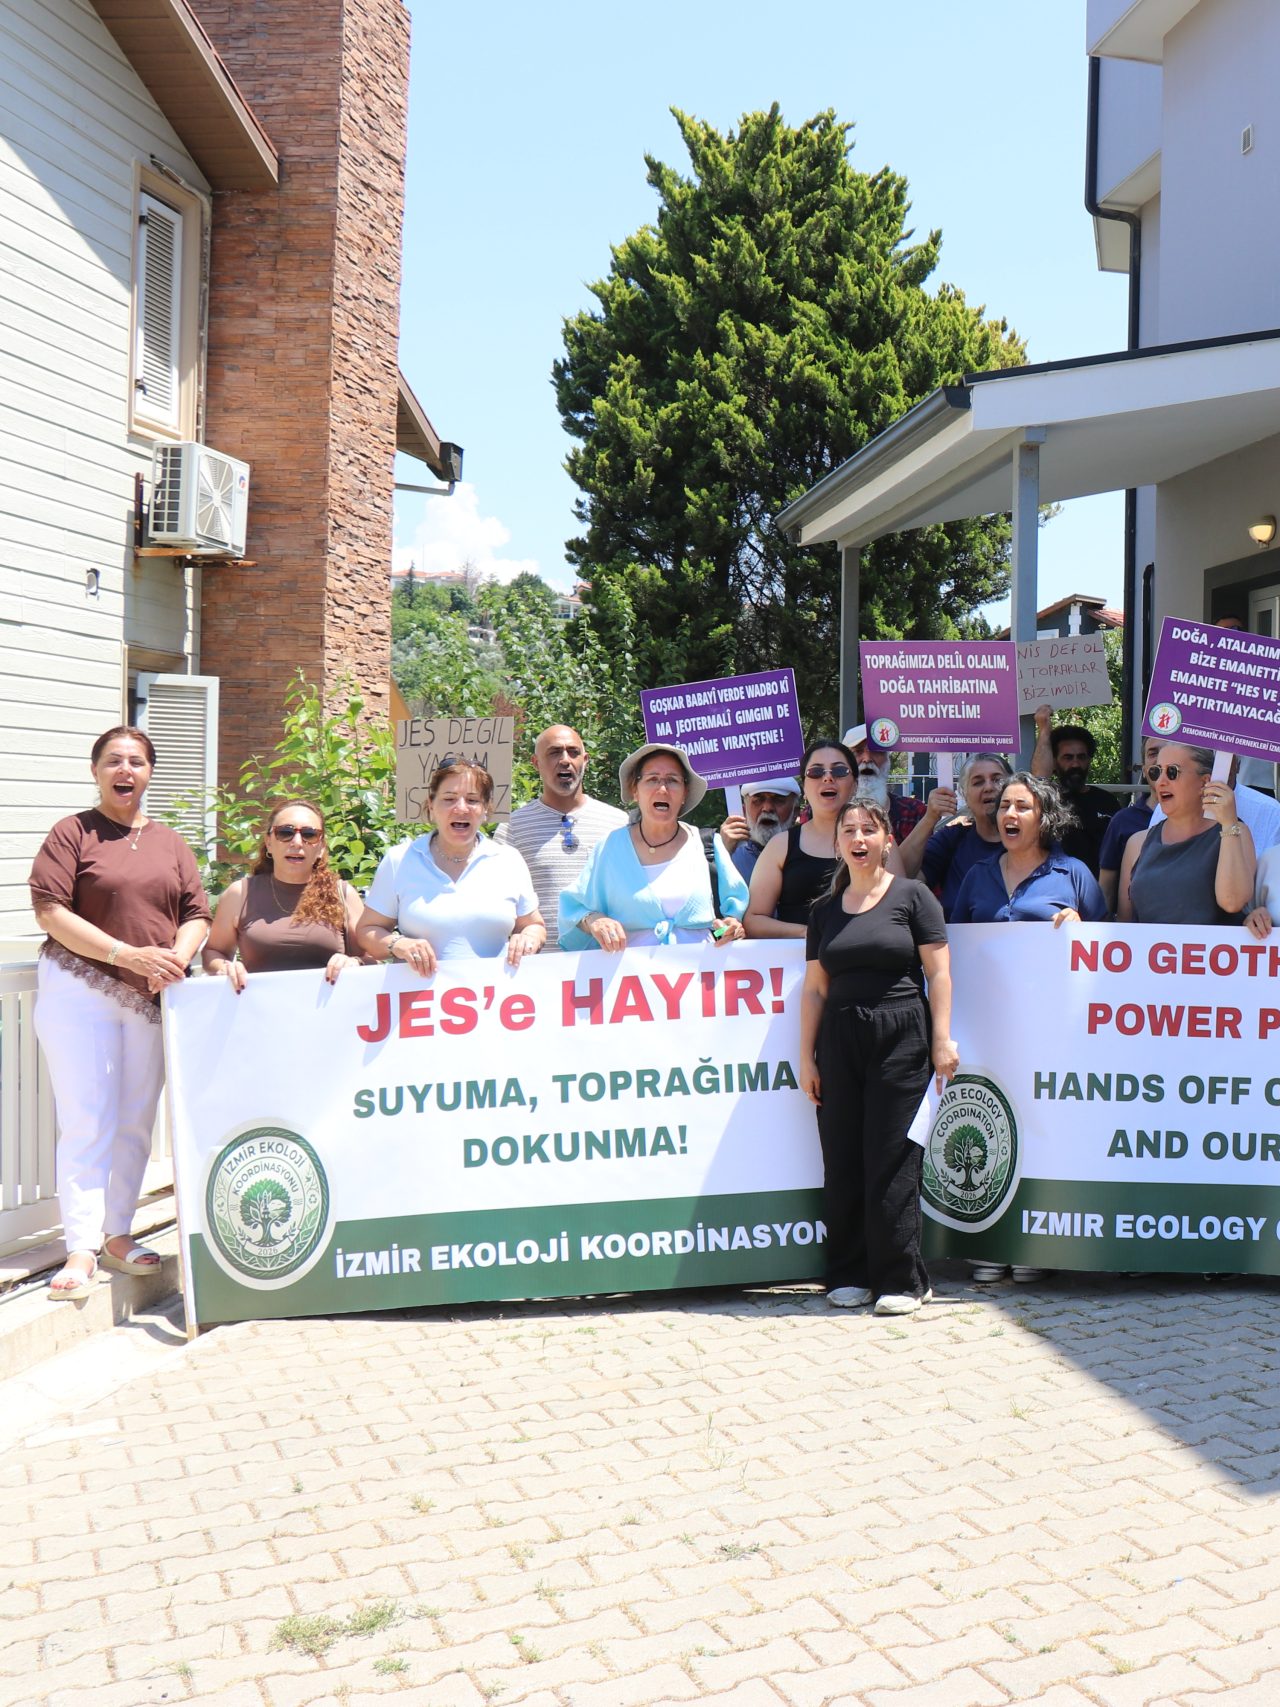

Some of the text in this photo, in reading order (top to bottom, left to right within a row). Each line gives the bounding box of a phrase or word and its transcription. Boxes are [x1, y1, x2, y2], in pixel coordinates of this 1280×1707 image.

[1171, 627, 1209, 646] DOĞA
[865, 651, 1009, 672] TOPRAĞIMIZA DELÎL OLALIM,
[1189, 650, 1217, 668] BİZE
[650, 695, 685, 716] GOŞKAR
[685, 687, 717, 708] BABAYÎ
[717, 686, 745, 703] VERDE
[745, 680, 778, 699] WADBO
[880, 675, 998, 694] DOĞA TAHRİBATINA
[1169, 669, 1229, 692] EMANETE
[1262, 688, 1278, 702] VE
[656, 703, 790, 738] MA JEOTERMALÎ GIMGIM DE
[900, 700, 981, 719] DUR DİYELİM!
[399, 719, 436, 748] JES
[722, 729, 780, 751] VIRAYŞTENE
[1182, 726, 1218, 741] DEMOKRATİK
[1218, 733, 1235, 744] ALEVİ
[1235, 736, 1269, 750] DERNEKLERİ
[1070, 940, 1133, 973] NO
[561, 967, 785, 1027] HAYIR!
[1087, 1002, 1242, 1039] POWER
[353, 1056, 799, 1119] SUYUMA, TOPRAĞIMA
[960, 1087, 1003, 1120] ECOLOGY
[1033, 1071, 1165, 1103] HANDS
[1178, 1075, 1252, 1105] OFF
[937, 1107, 995, 1140] COORDINATION
[222, 1141, 308, 1176] İZMİR EKOLOJİ
[463, 1124, 688, 1168] DOKUNMA!
[1107, 1129, 1189, 1159] AND
[232, 1161, 299, 1196] KOORDİNASYONU
[960, 1190, 977, 1199] 2026
[1022, 1209, 1104, 1238] IZMIR
[1115, 1214, 1267, 1241] ECOLOGY
[257, 1247, 279, 1256] 2026
[335, 1243, 422, 1278] İZMİR
[431, 1231, 569, 1270] EKOLOJİ
